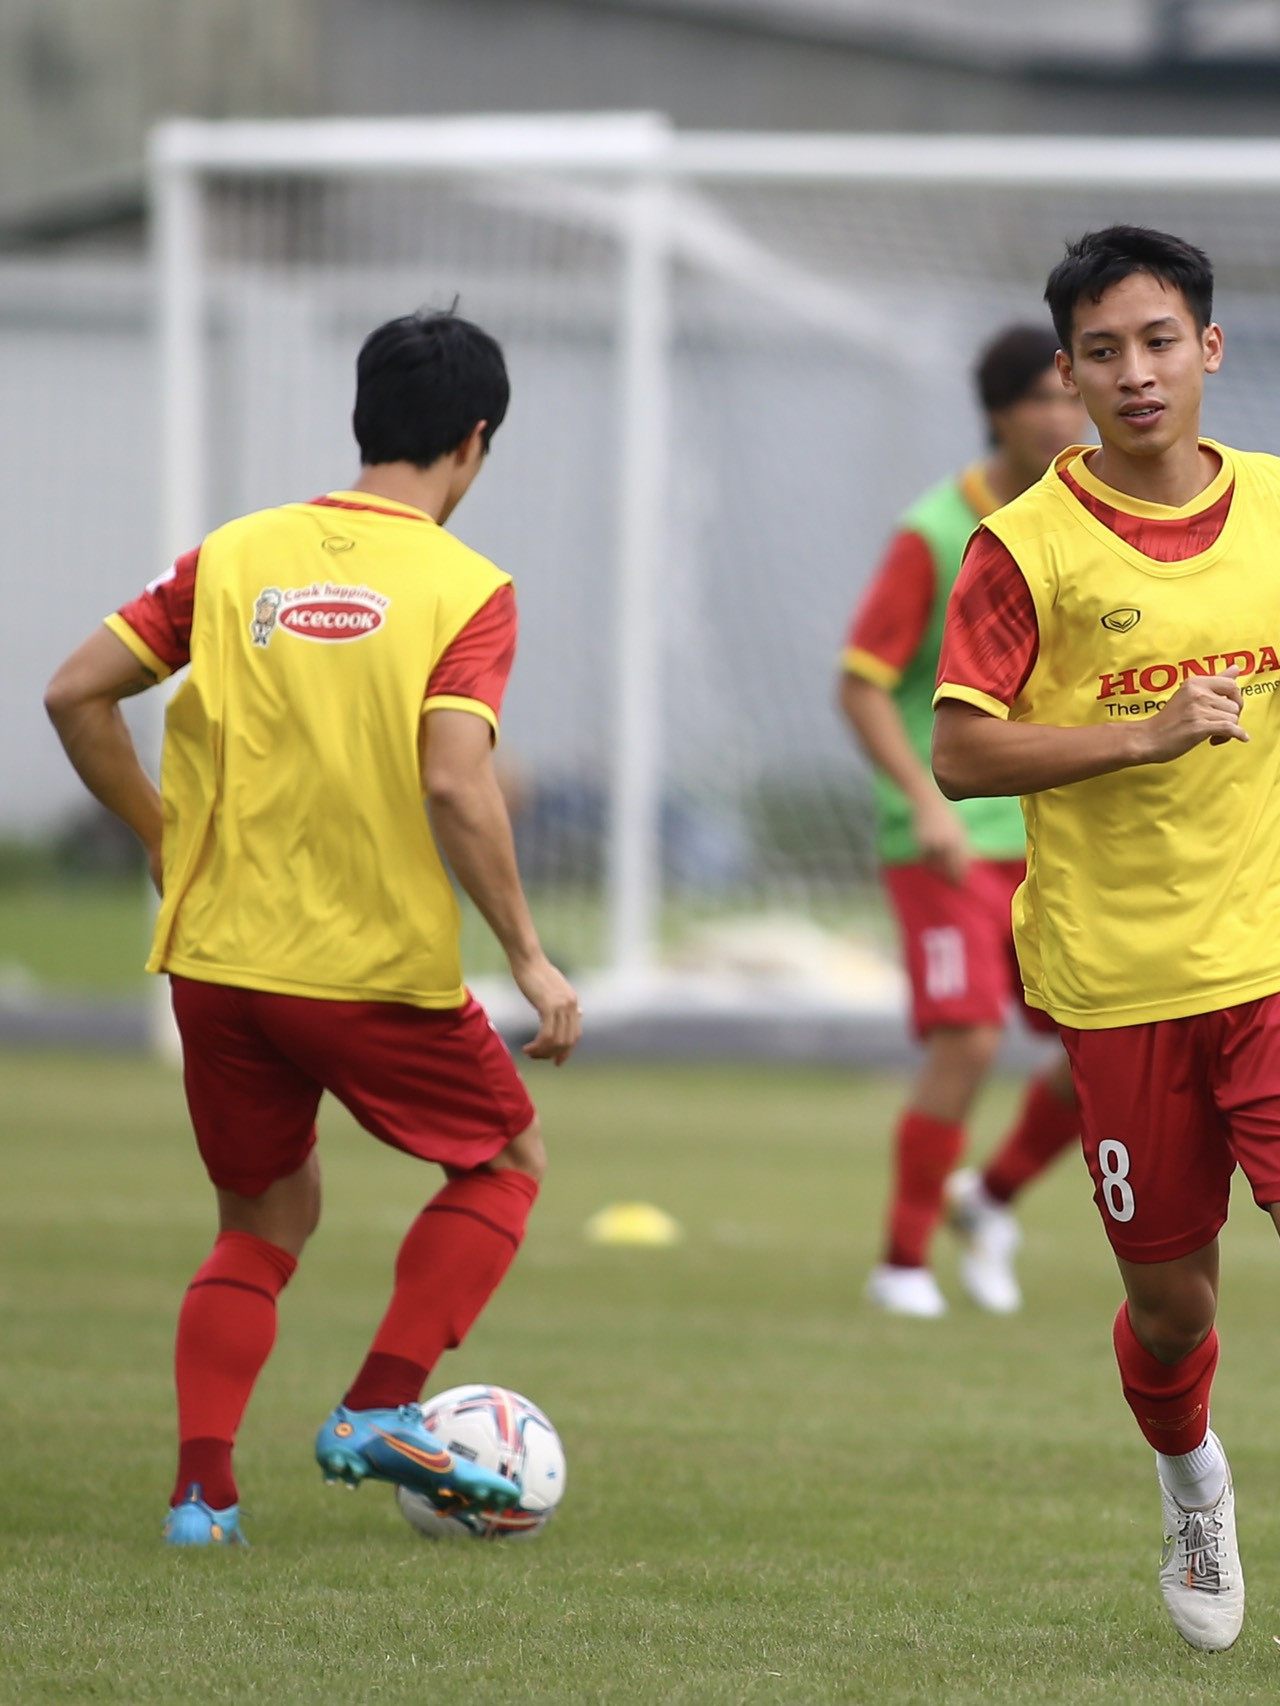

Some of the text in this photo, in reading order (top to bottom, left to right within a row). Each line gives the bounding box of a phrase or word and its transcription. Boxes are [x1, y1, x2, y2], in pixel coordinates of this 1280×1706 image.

[284, 583, 387, 607] Cook happiness
[1096, 646, 1280, 700] HONDA
[1104, 703, 1140, 716] The
[1241, 680, 1280, 697] reams
[1098, 1139, 1135, 1222] 8
